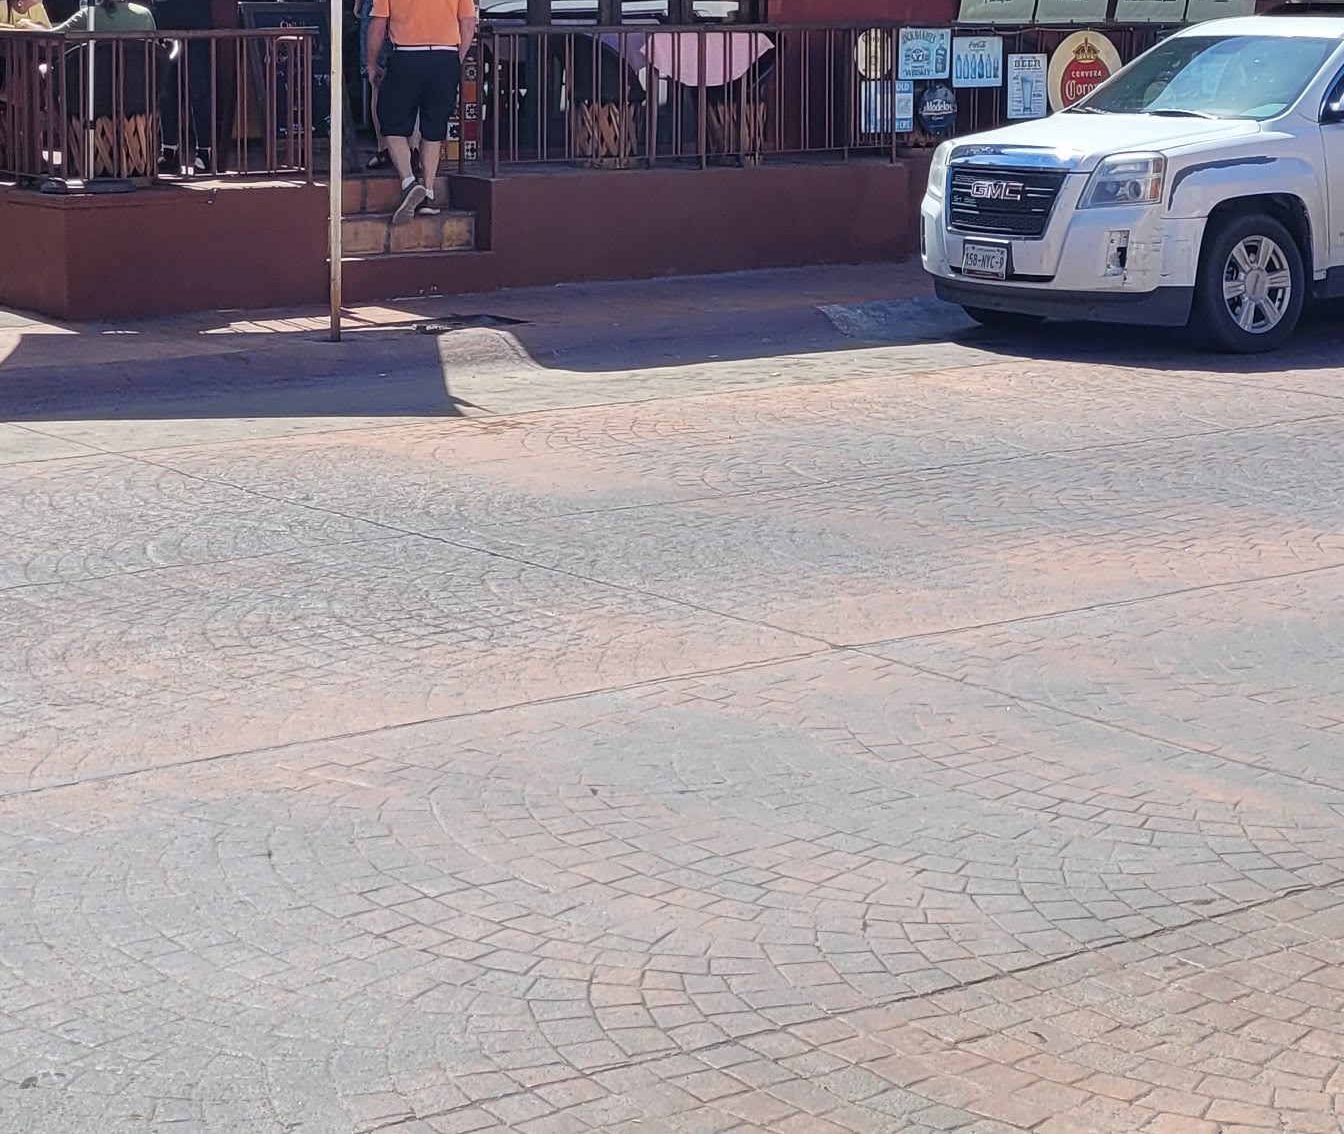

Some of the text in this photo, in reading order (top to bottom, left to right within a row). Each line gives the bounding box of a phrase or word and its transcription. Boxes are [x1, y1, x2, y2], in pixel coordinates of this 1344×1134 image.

[1013, 59, 1041, 69] BEER
[1071, 69, 1102, 79] CERVEZA
[923, 99, 953, 113] Modelo
[971, 180, 1025, 201] GMC
